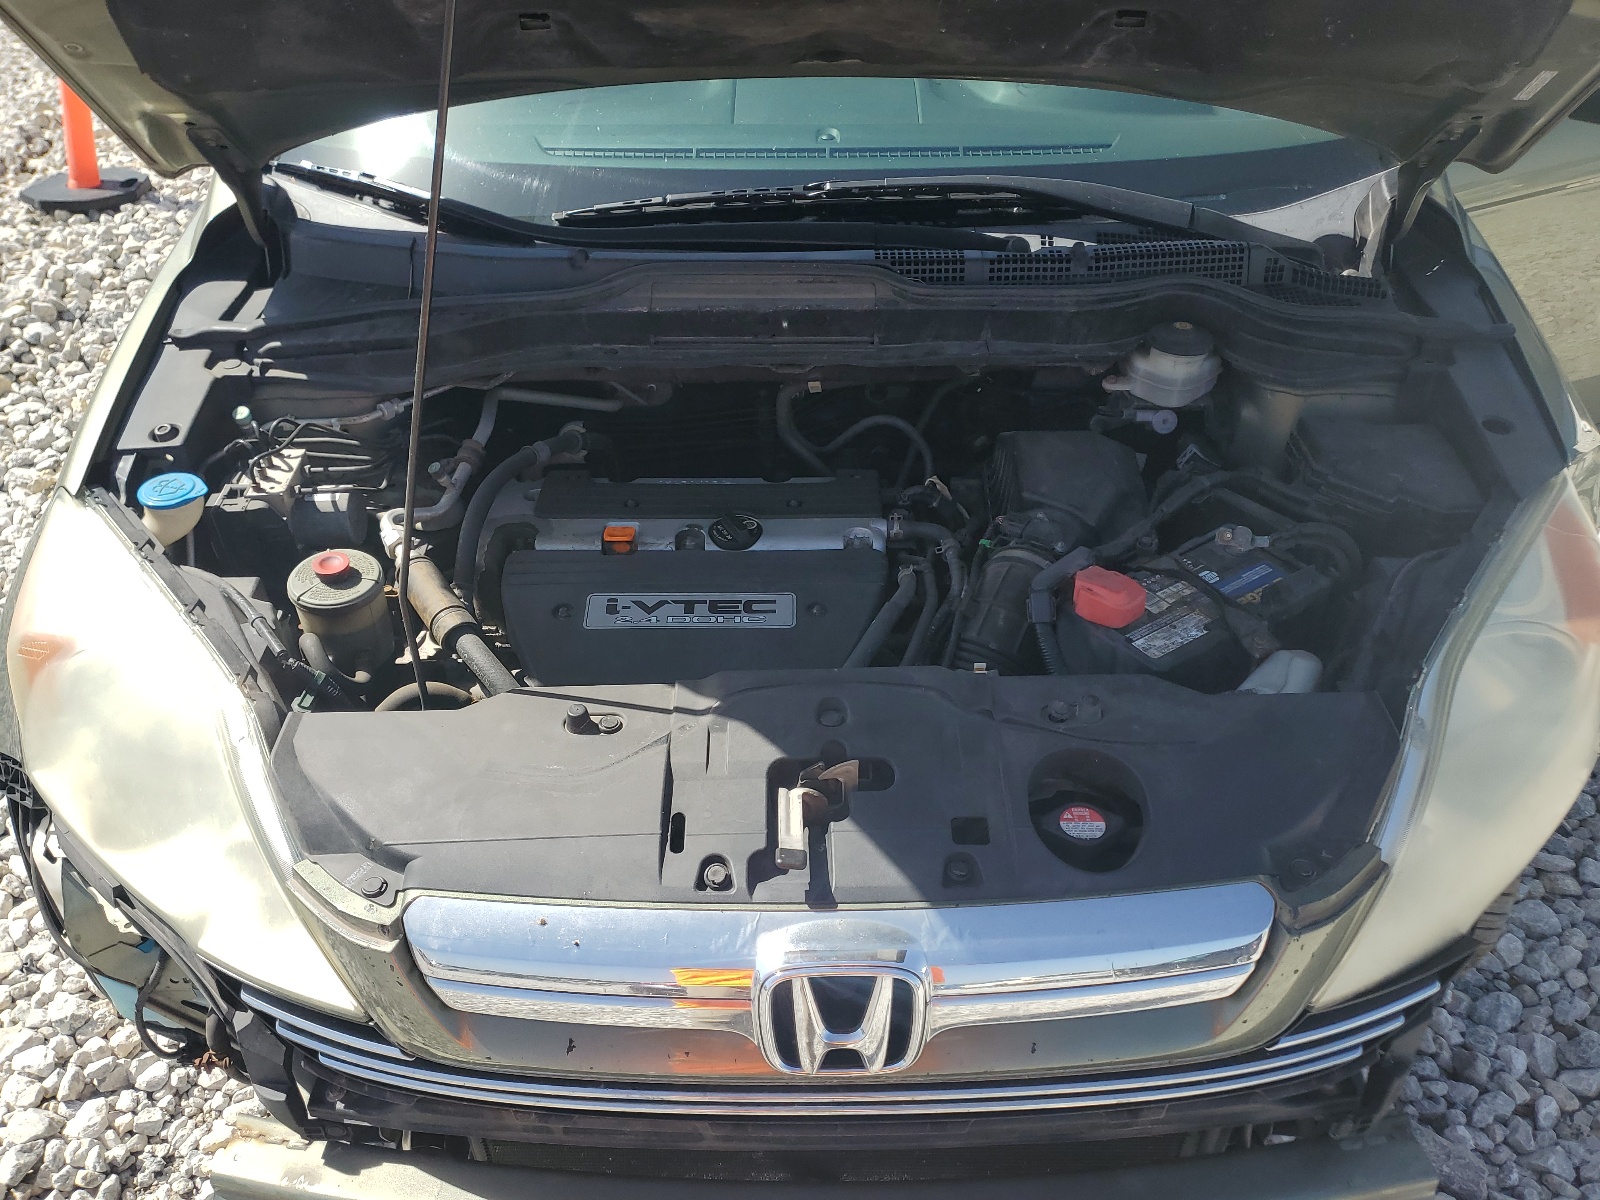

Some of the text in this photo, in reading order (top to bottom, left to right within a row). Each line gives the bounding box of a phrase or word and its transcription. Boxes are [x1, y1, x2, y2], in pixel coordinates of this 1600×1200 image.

[606, 598, 777, 615] i-VTEC
[614, 616, 767, 624] 2.4 DOHC
